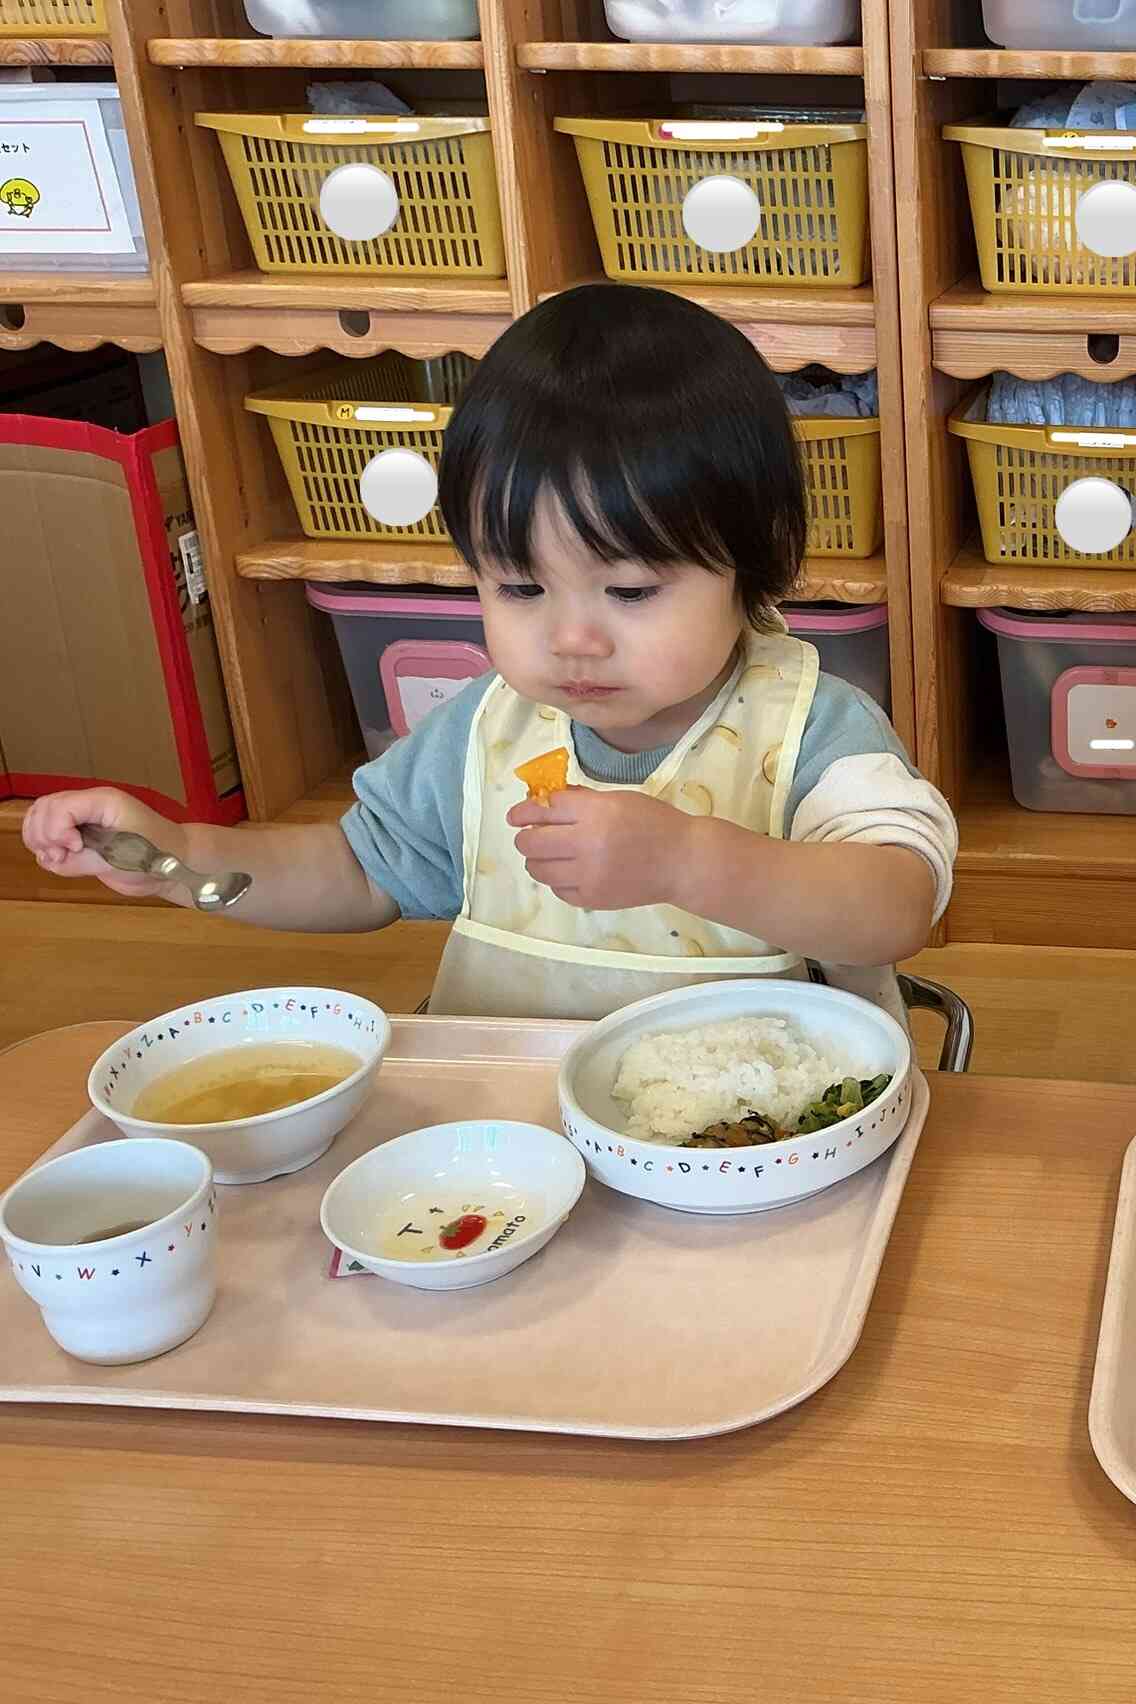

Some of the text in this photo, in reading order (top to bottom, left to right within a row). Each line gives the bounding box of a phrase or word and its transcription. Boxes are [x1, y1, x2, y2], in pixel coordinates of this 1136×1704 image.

[0, 143, 30, 154] セット
[140, 1034, 154, 1048] Z
[168, 1027, 180, 1039] A
[193, 1011, 203, 1024] B
[222, 1011, 232, 1023] C
[251, 1002, 264, 1013] D
[284, 998, 297, 1012] E
[310, 1006, 318, 1018] F
[616, 1145, 625, 1157] B
[643, 1160, 654, 1172] C
[678, 1162, 691, 1174] D
[719, 1161, 732, 1174] E
[754, 1165, 765, 1178] F
[787, 1153, 799, 1165] G
[824, 1147, 838, 1160] H
[855, 1125, 864, 1138] I
[396, 1222, 423, 1237] T
[487, 1215, 526, 1252] omato
[32, 1222, 193, 1281] V W X Y
